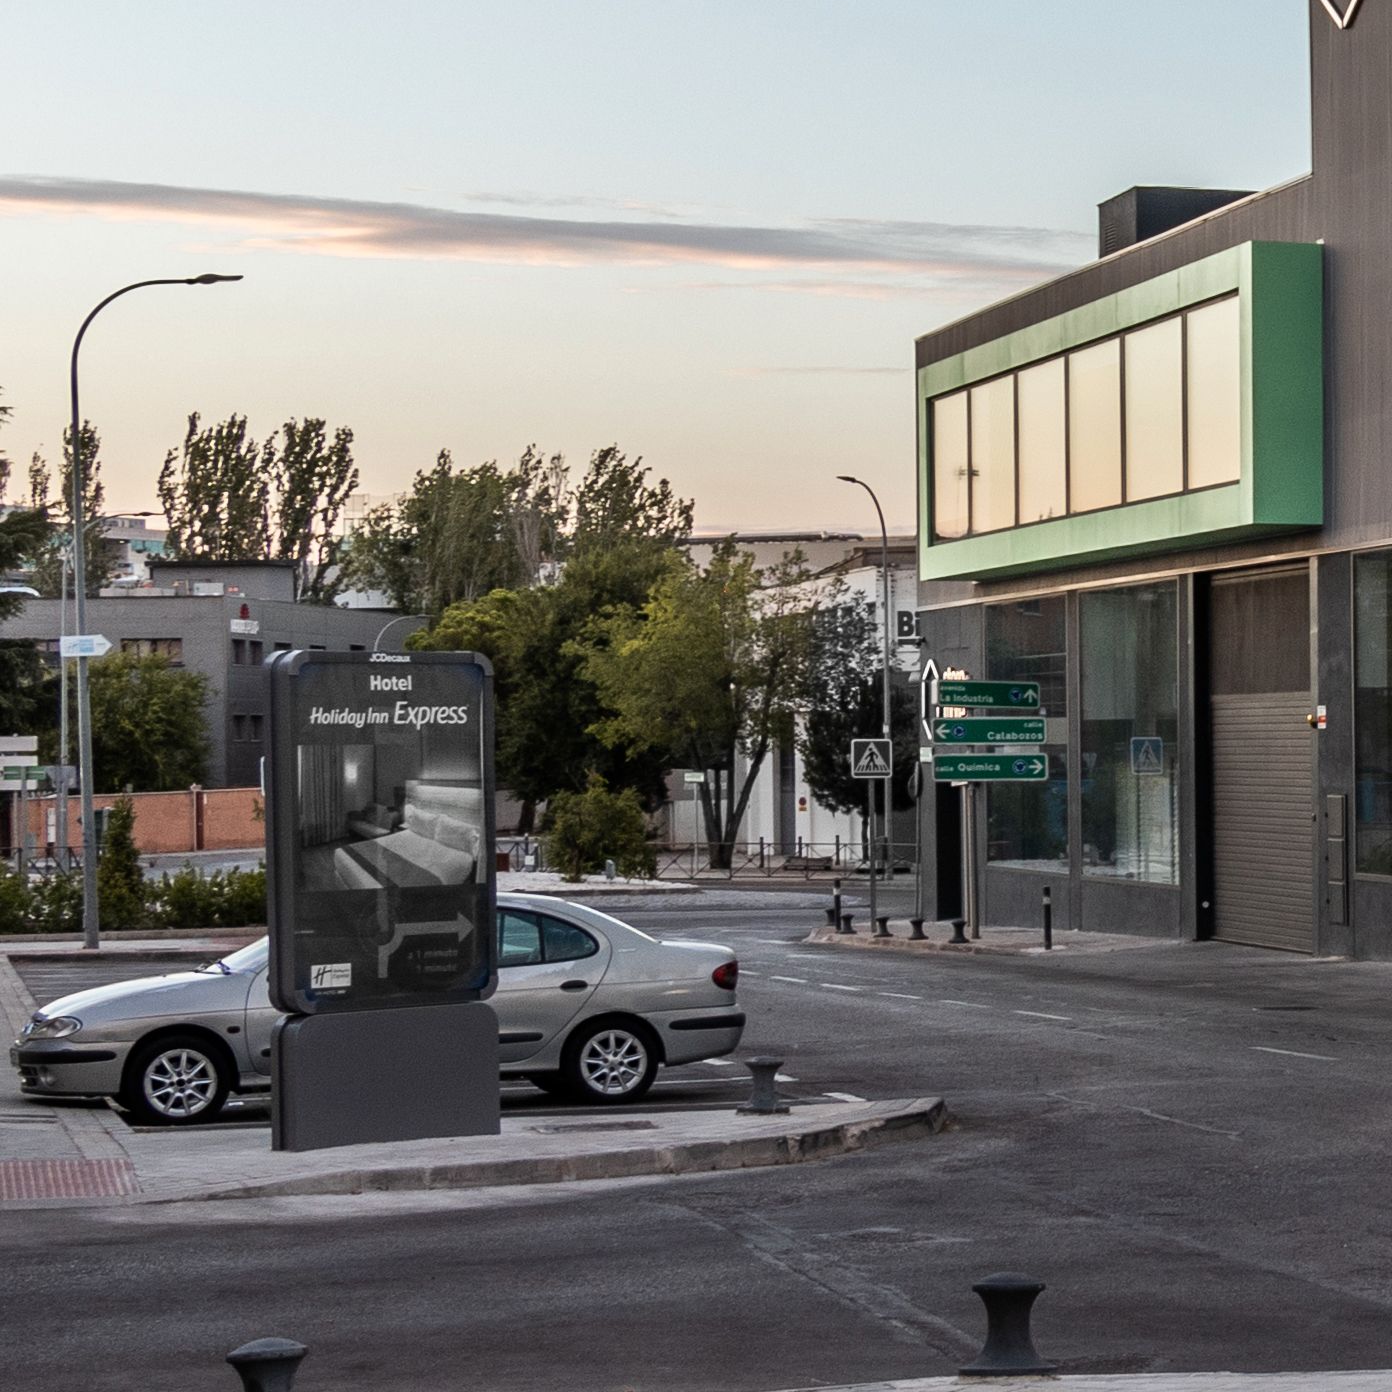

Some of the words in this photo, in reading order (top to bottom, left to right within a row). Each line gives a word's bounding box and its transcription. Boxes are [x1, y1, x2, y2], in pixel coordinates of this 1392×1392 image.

[369, 653, 411, 662] JCDecaux
[370, 675, 412, 691] Hotel
[940, 694, 951, 702] La
[953, 694, 994, 703] Industria
[310, 707, 366, 728] Holiday
[367, 708, 389, 724] Inn
[394, 701, 468, 730] Express
[987, 731, 1043, 741] Calabozos
